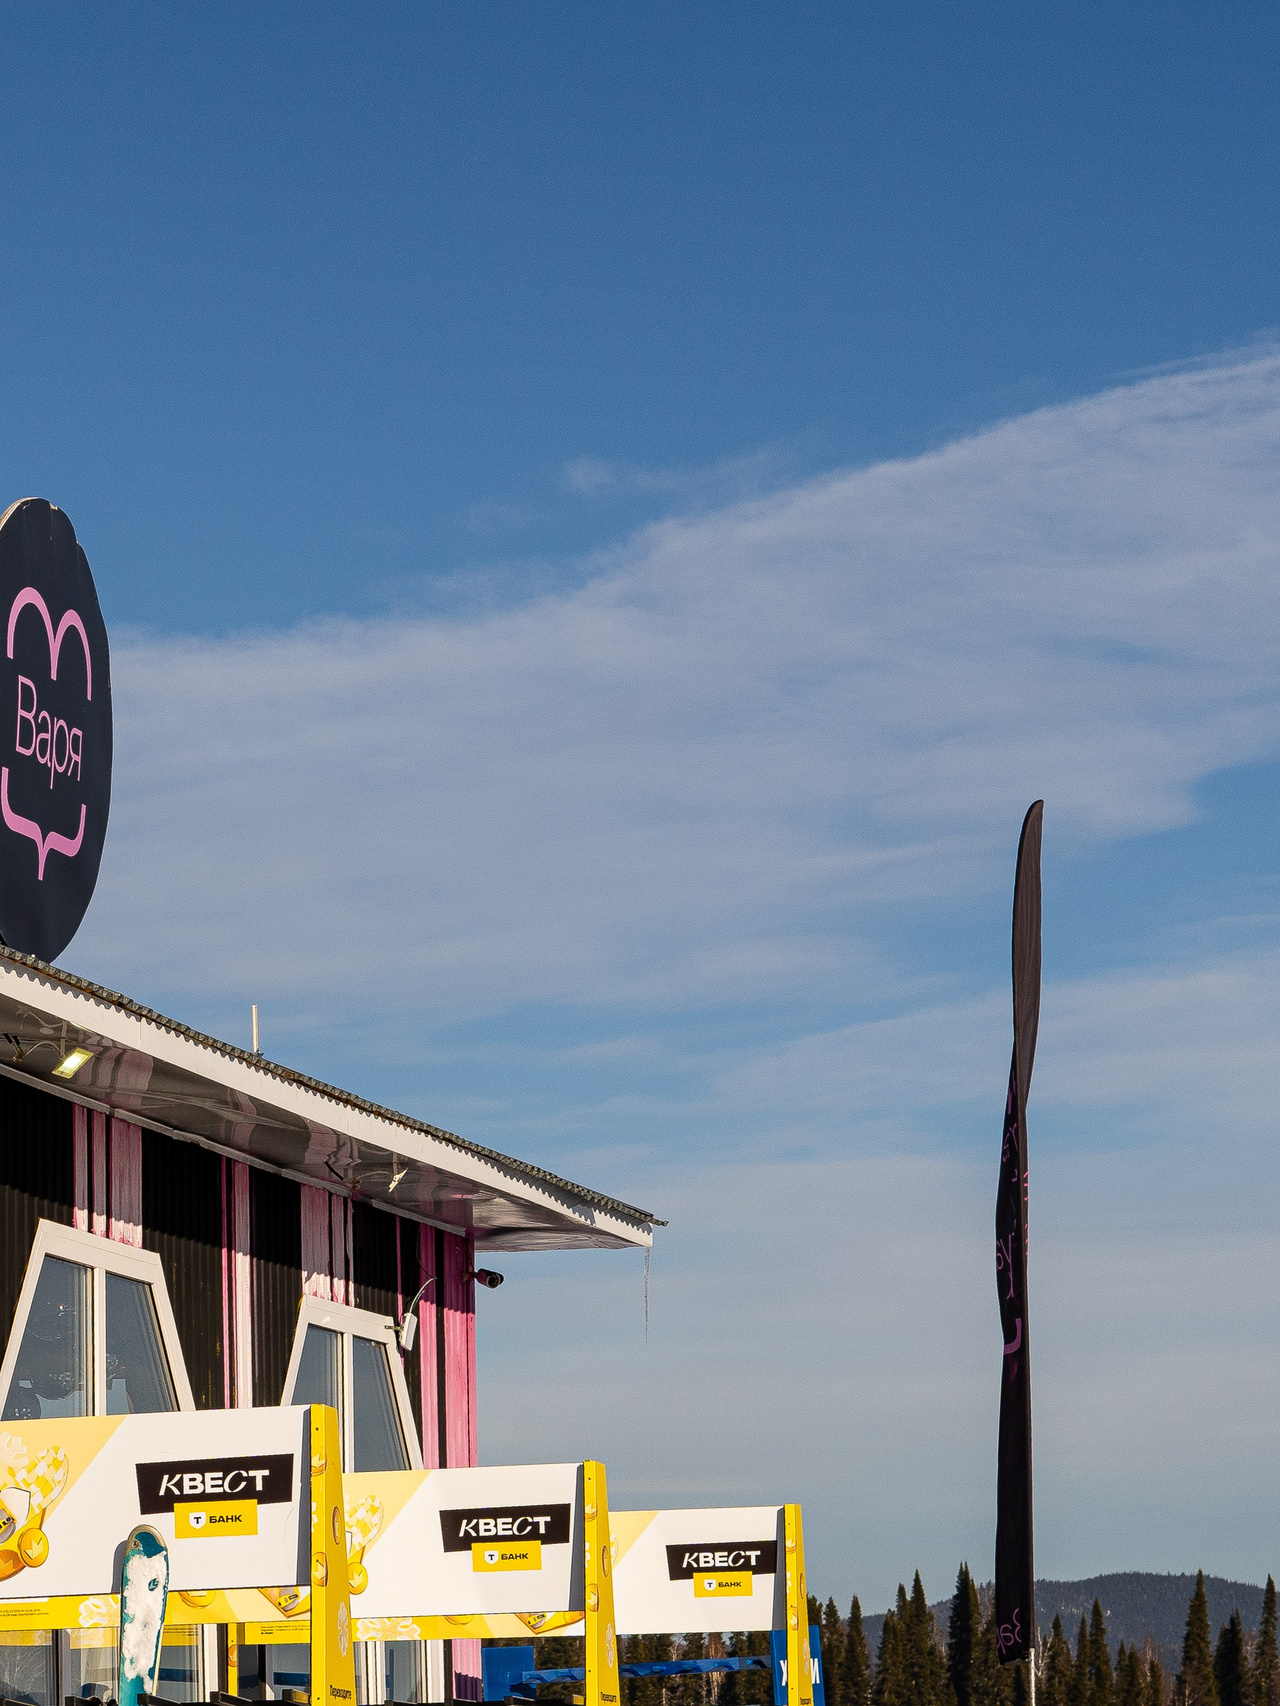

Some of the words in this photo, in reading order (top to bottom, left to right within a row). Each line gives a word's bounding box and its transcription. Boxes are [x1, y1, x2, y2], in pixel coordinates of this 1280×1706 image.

[15, 674, 83, 790] Варя
[158, 1469, 270, 1496] КВЕСТ
[209, 1515, 243, 1524] БАНК
[458, 1516, 551, 1537] КВЕСТ
[500, 1552, 529, 1561] БАНК
[682, 1550, 761, 1568] КВЕСТ
